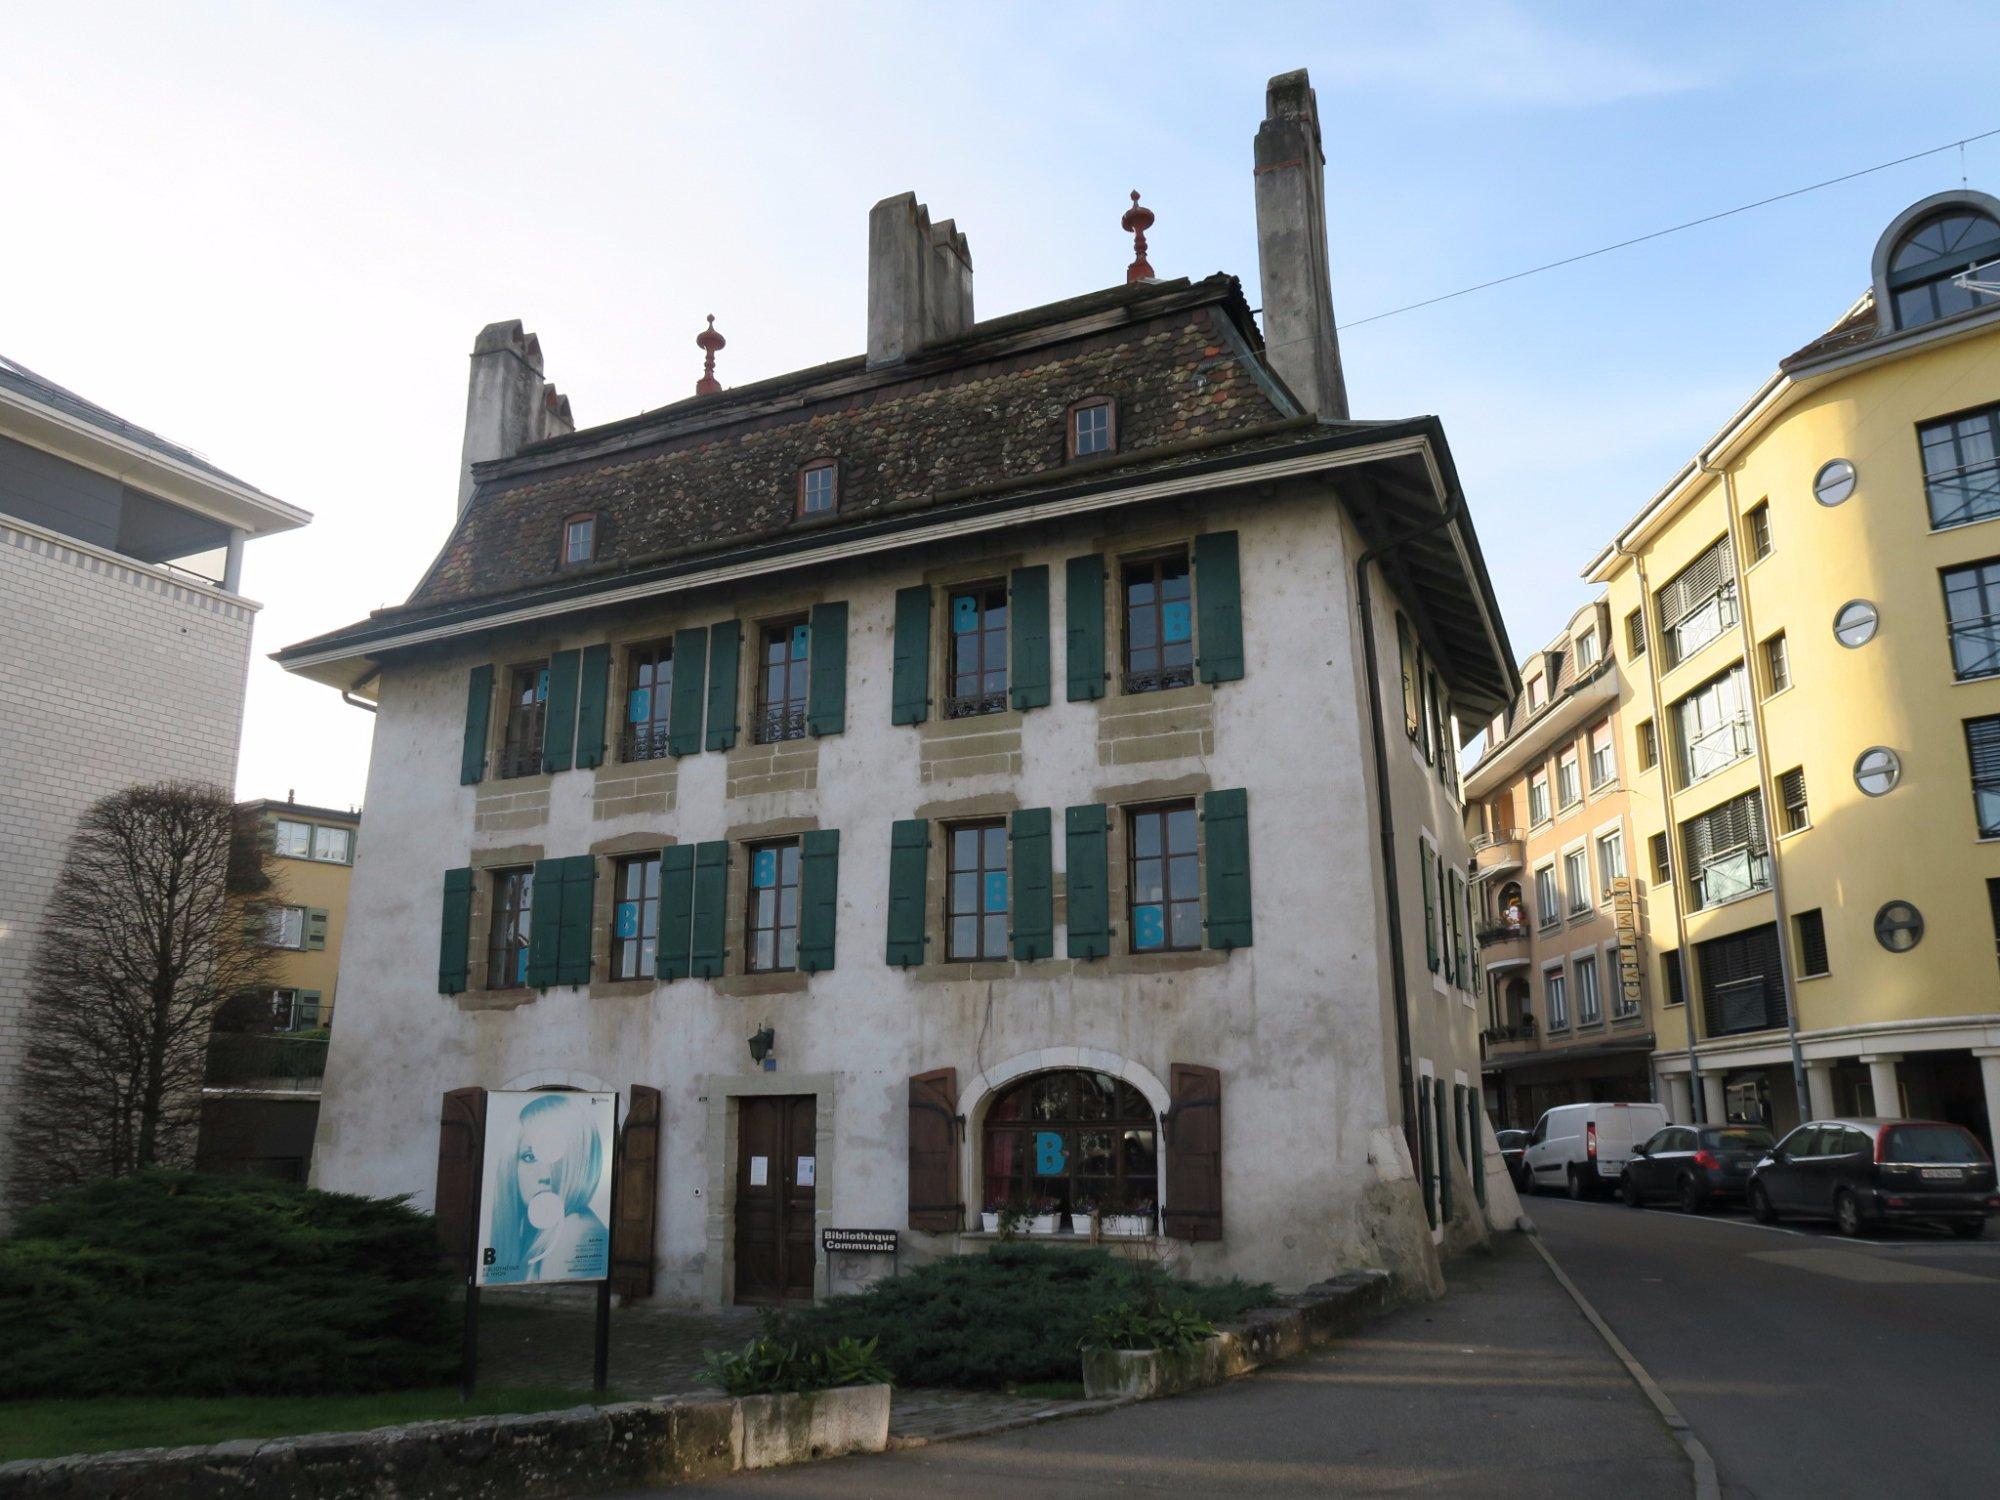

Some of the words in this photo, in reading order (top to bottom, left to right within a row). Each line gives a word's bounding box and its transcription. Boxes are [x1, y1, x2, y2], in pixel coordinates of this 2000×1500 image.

[1164, 602, 1192, 642] B
[630, 690, 650, 723] B
[754, 851, 775, 888] B
[985, 871, 1008, 912] B
[617, 902, 638, 939] B
[1136, 905, 1164, 948] B
[1614, 880, 1640, 998] CATAMBO
[1036, 1131, 1066, 1175] B
[824, 1230, 896, 1242] Bibliothèque
[826, 1241, 895, 1250] Communale
[484, 1247, 496, 1265] B
